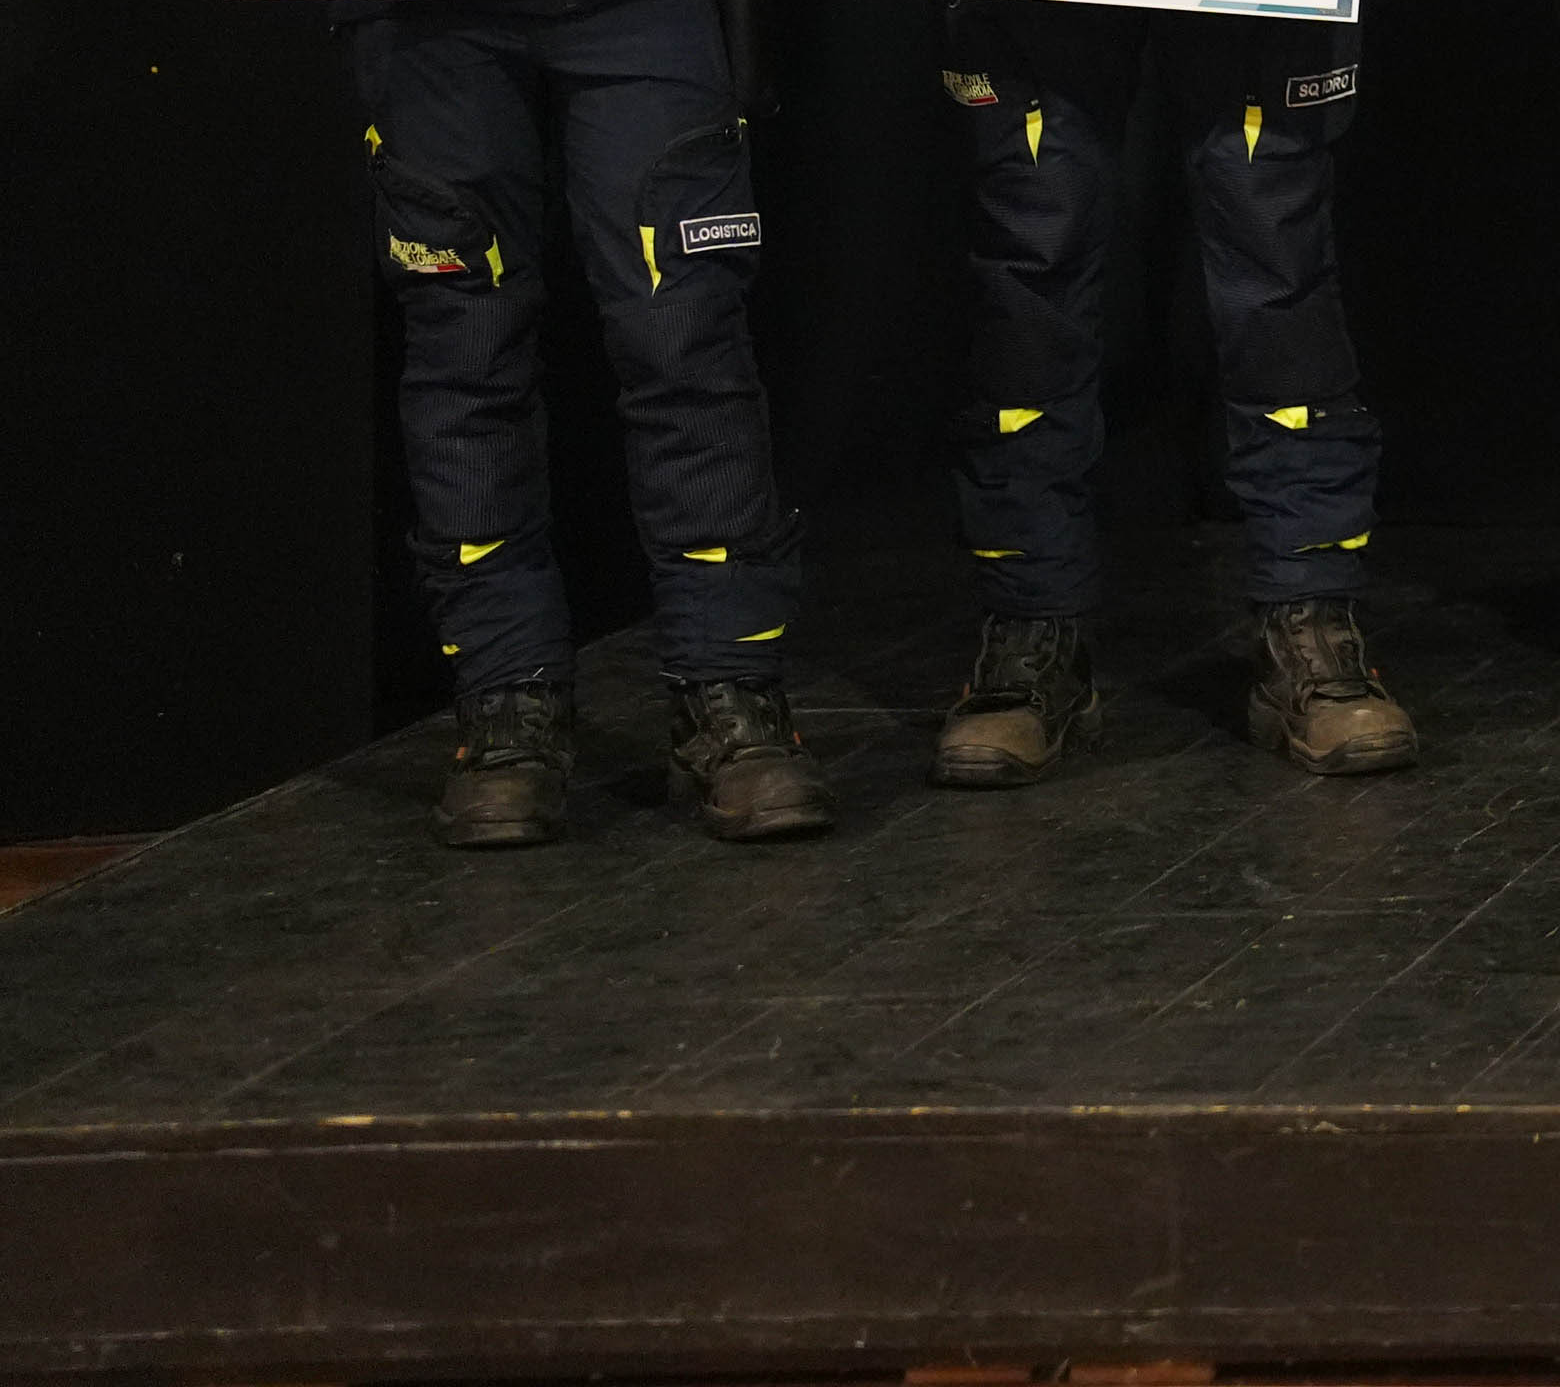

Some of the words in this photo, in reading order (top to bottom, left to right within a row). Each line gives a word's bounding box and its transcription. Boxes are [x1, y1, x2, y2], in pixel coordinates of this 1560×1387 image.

[1299, 82, 1320, 98] SQ
[1322, 74, 1349, 96] IDRO
[689, 222, 757, 243] LOGISTICA
